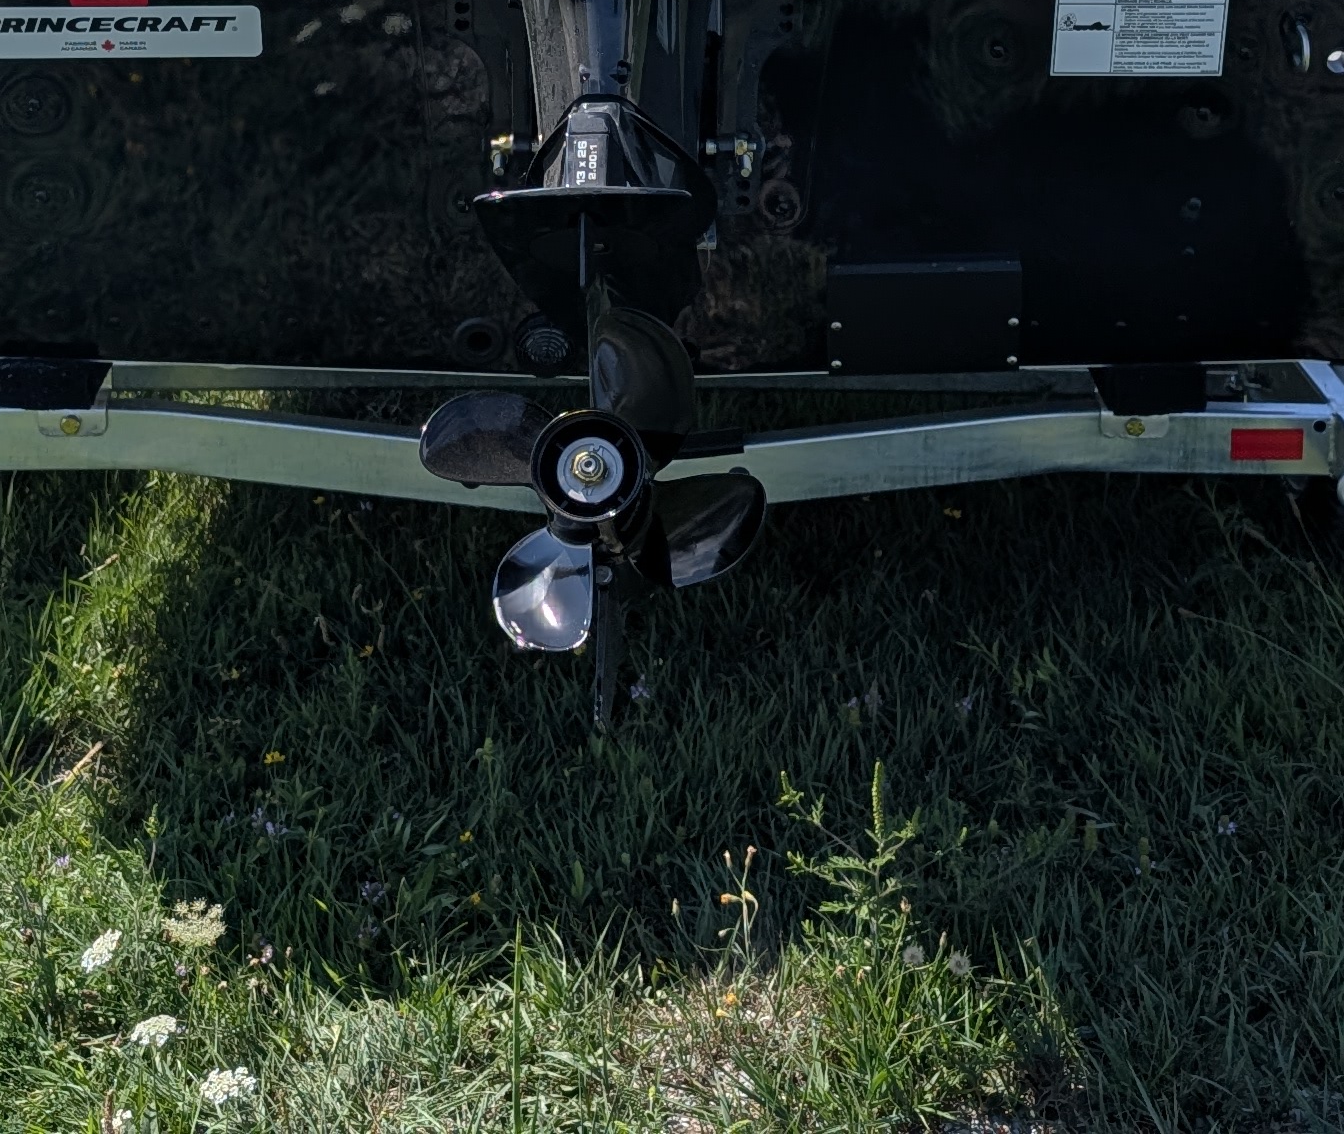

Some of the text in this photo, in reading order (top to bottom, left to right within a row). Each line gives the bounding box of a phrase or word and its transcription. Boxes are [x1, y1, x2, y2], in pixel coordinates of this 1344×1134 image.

[577, 140, 587, 158] 26
[588, 145, 597, 180] 2.00:1
[576, 171, 586, 185] 13
